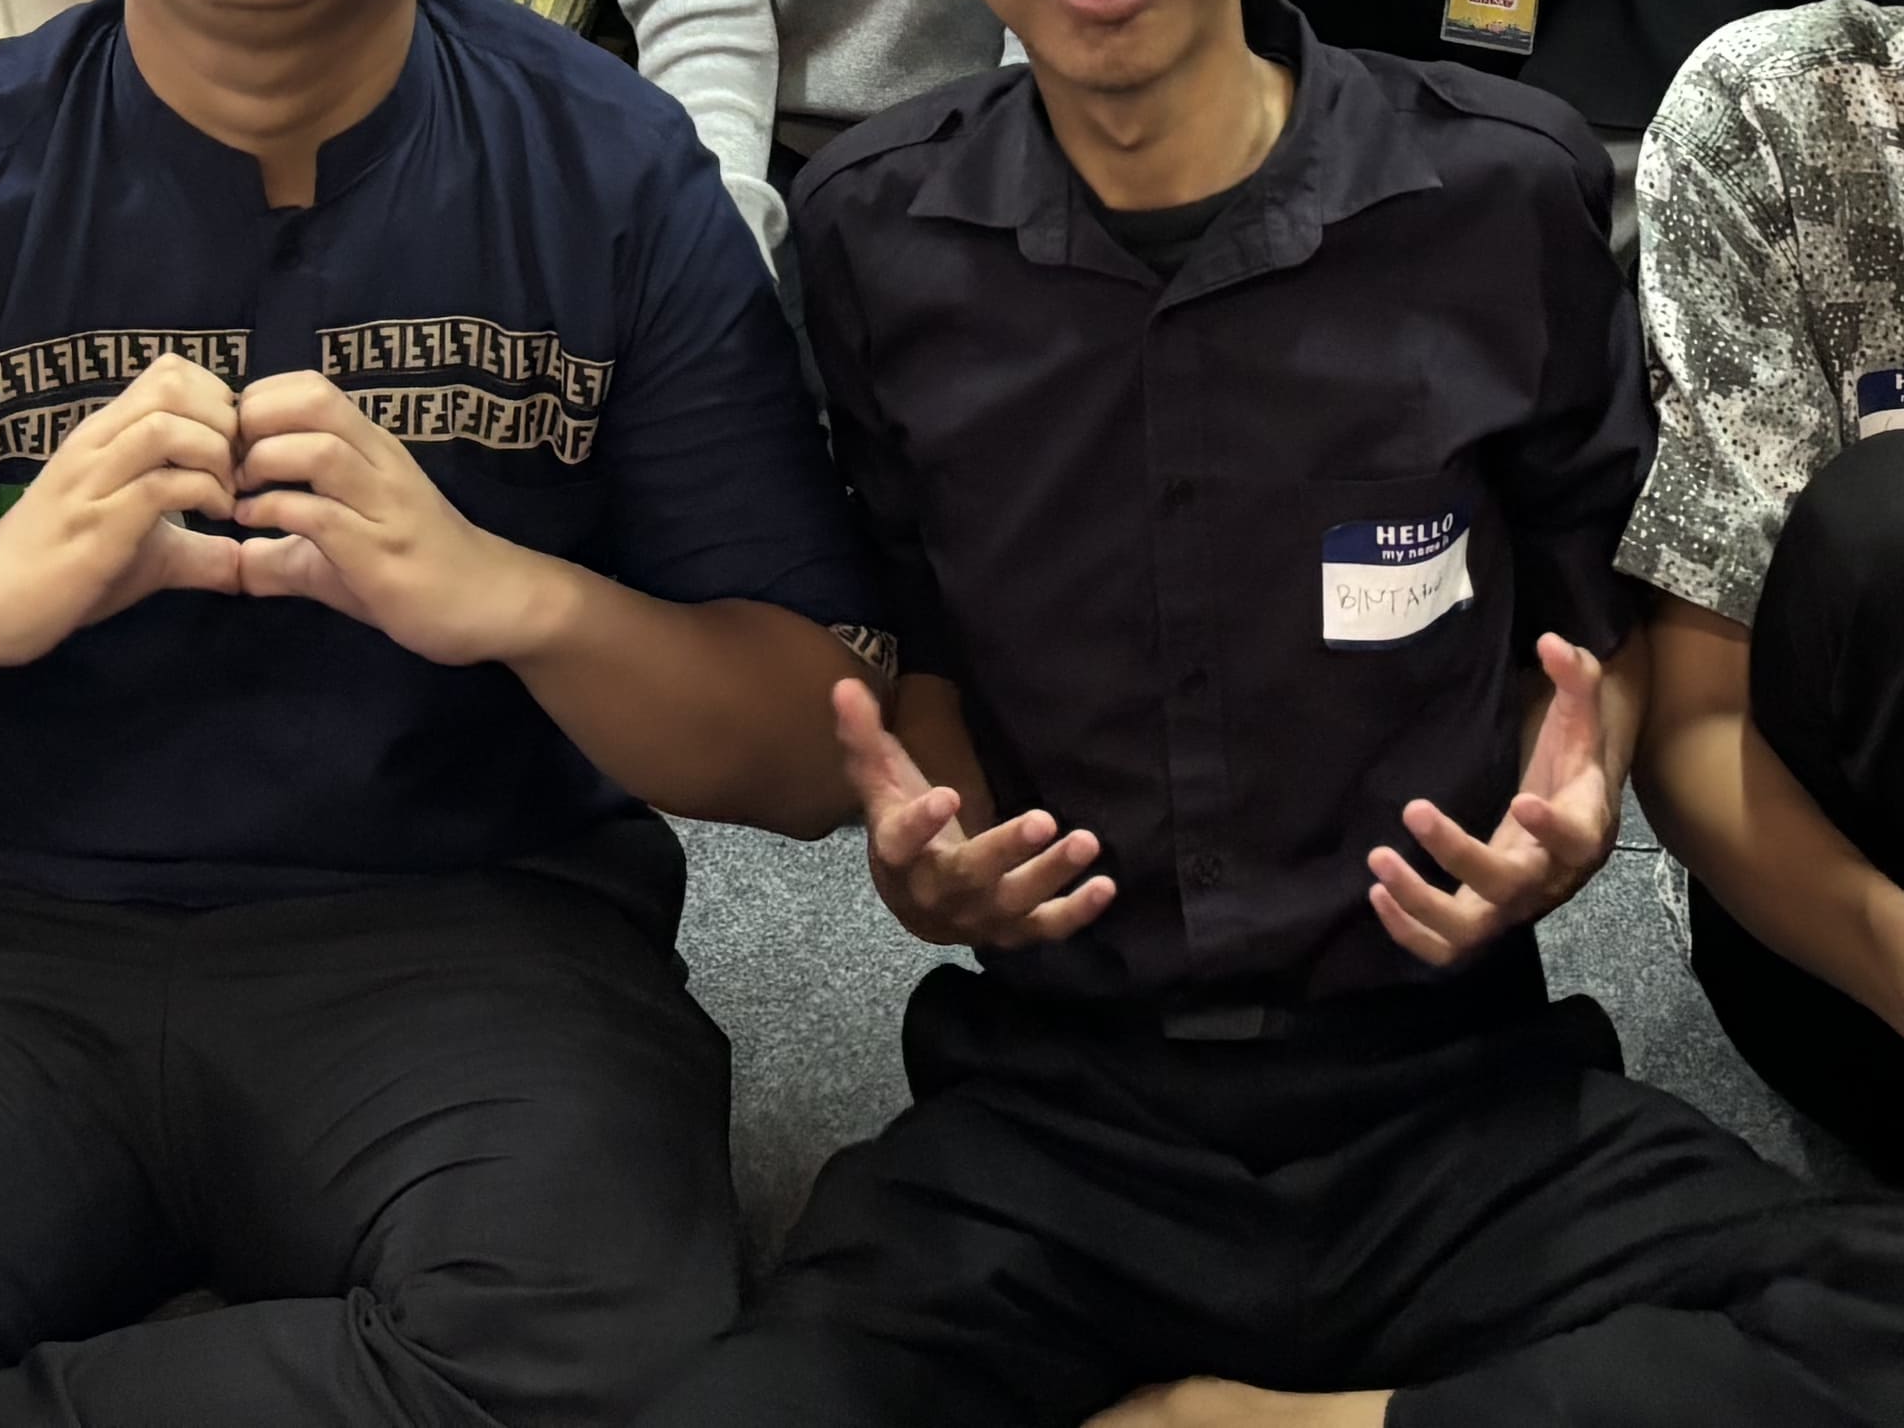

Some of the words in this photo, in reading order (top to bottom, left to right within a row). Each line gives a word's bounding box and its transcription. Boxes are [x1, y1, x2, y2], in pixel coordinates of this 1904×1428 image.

[1376, 513, 1454, 546] HELLO
[1382, 548, 1404, 564] my
[1408, 541, 1441, 559] name
